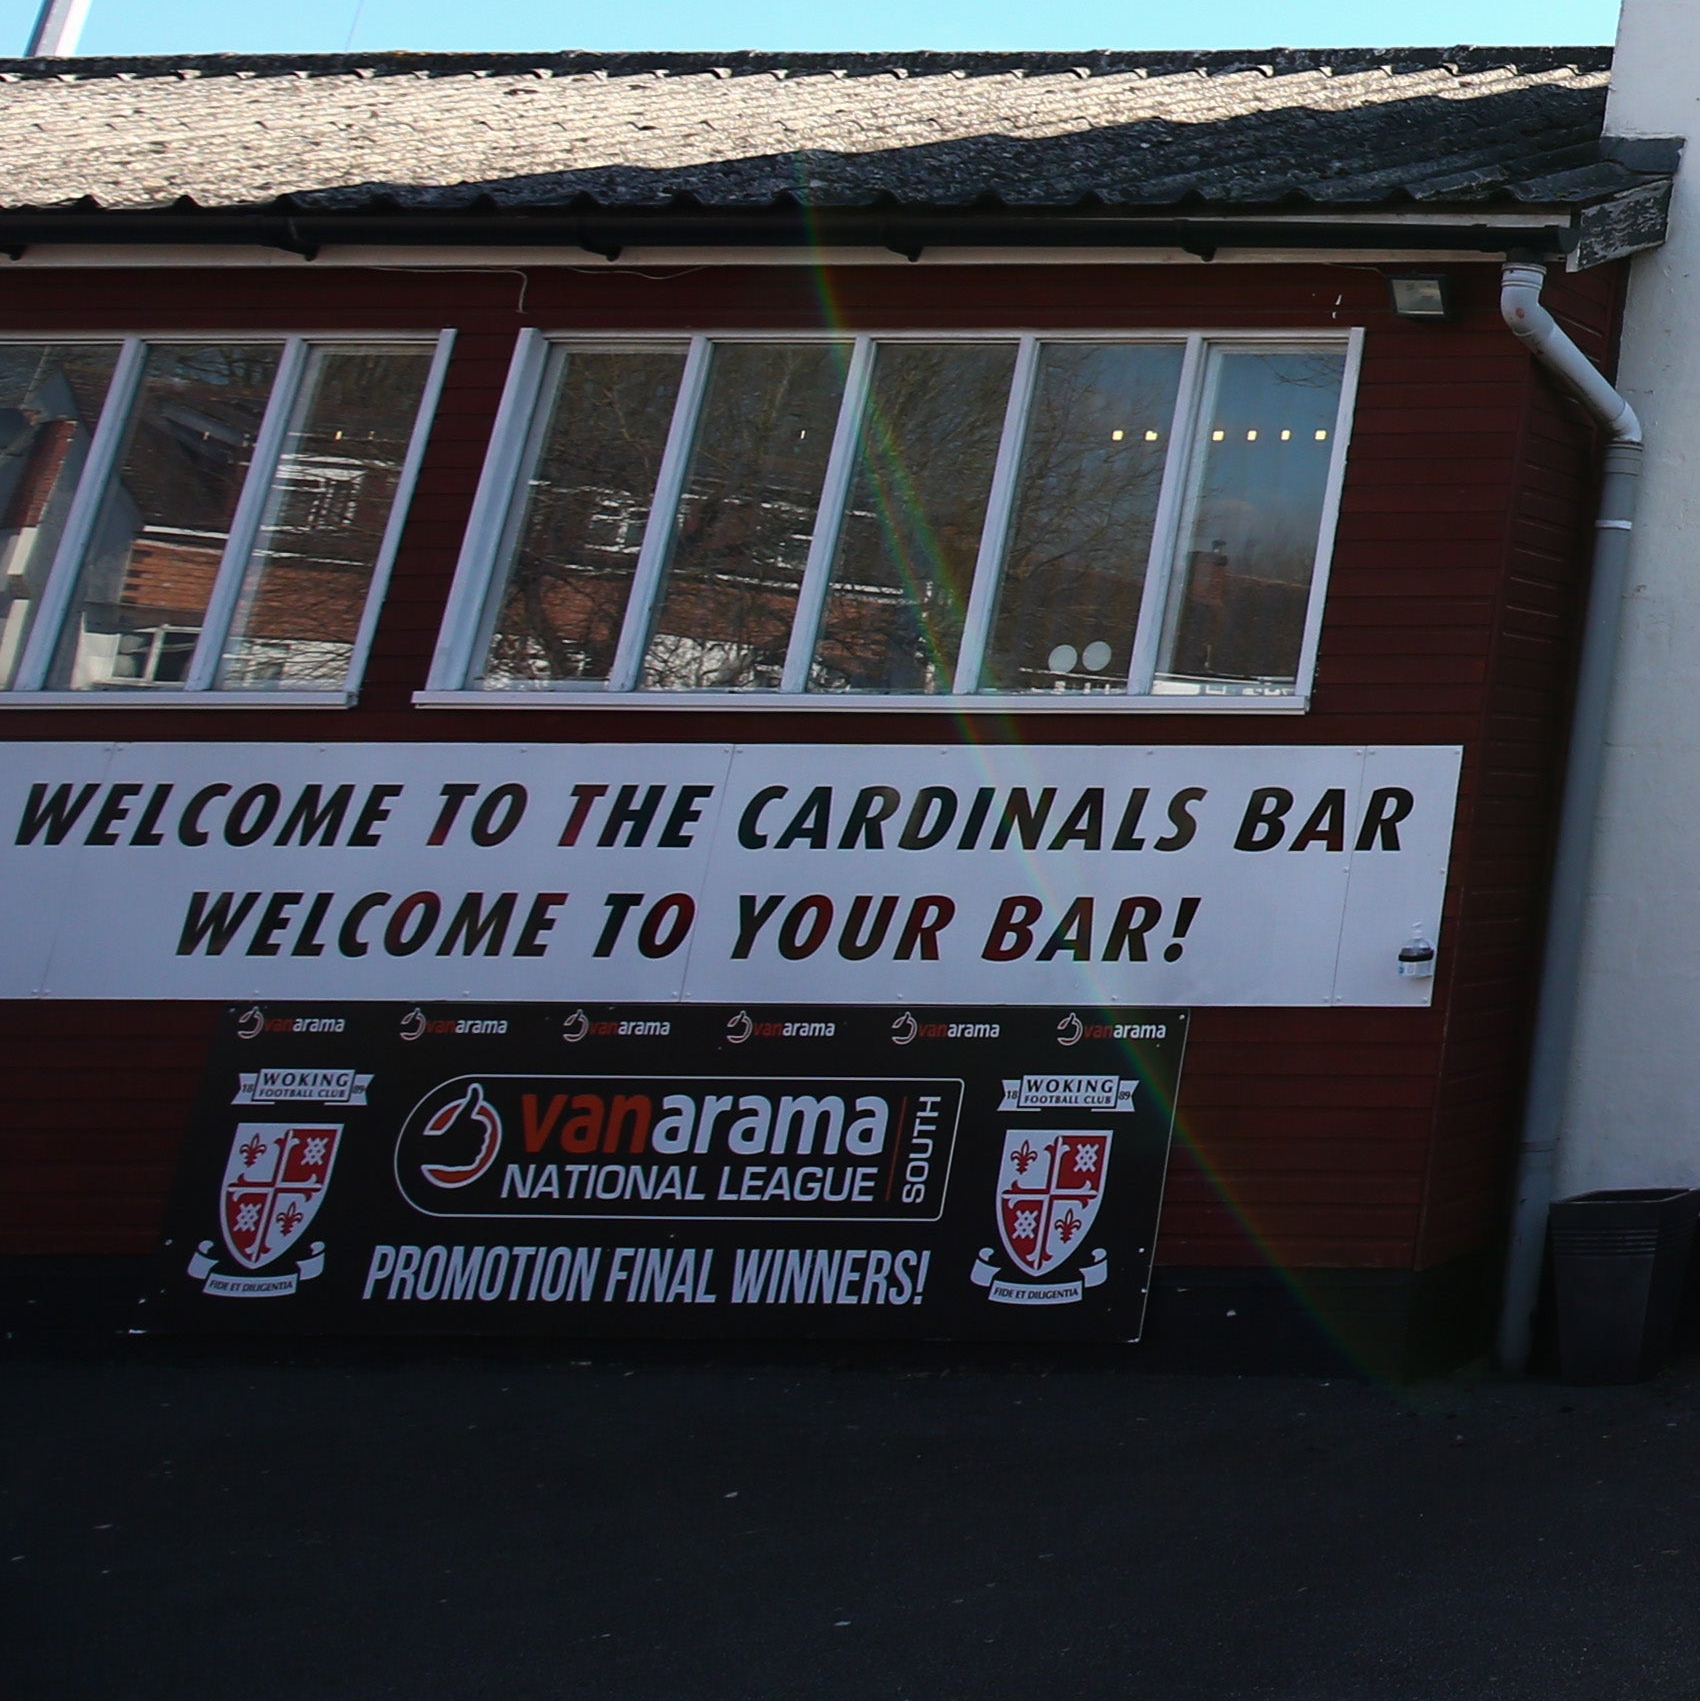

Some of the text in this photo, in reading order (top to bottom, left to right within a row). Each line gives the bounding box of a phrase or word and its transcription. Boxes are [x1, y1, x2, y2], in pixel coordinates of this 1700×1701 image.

[14, 783, 1414, 853] WELCOME TO THE CARDINALS BAR
[175, 891, 1202, 963] WELCOME TO YOUR BAR!
[265, 1018, 346, 1032] vanarama
[427, 1019, 508, 1034] vanarama
[589, 1020, 671, 1036] vanarama
[753, 1022, 836, 1037] vanarama
[918, 1023, 1000, 1038] vanarama
[1084, 1024, 1167, 1039] vanarama
[263, 1072, 349, 1087] WOKING
[1026, 1079, 1114, 1094] WOKING
[259, 1089, 345, 1098] FOOTBALL CLUB
[1024, 1095, 1112, 1105] FOOTBALL CLUB
[520, 1093, 890, 1156] vanarama
[901, 1095, 942, 1205] SOUTH
[500, 1163, 878, 1203] NATIONAL LEAGUE
[362, 1244, 931, 1306] PROMOTION FINAL WINNERS!
[230, 1282, 241, 1292] ET
[1015, 1290, 1026, 1299] ET
